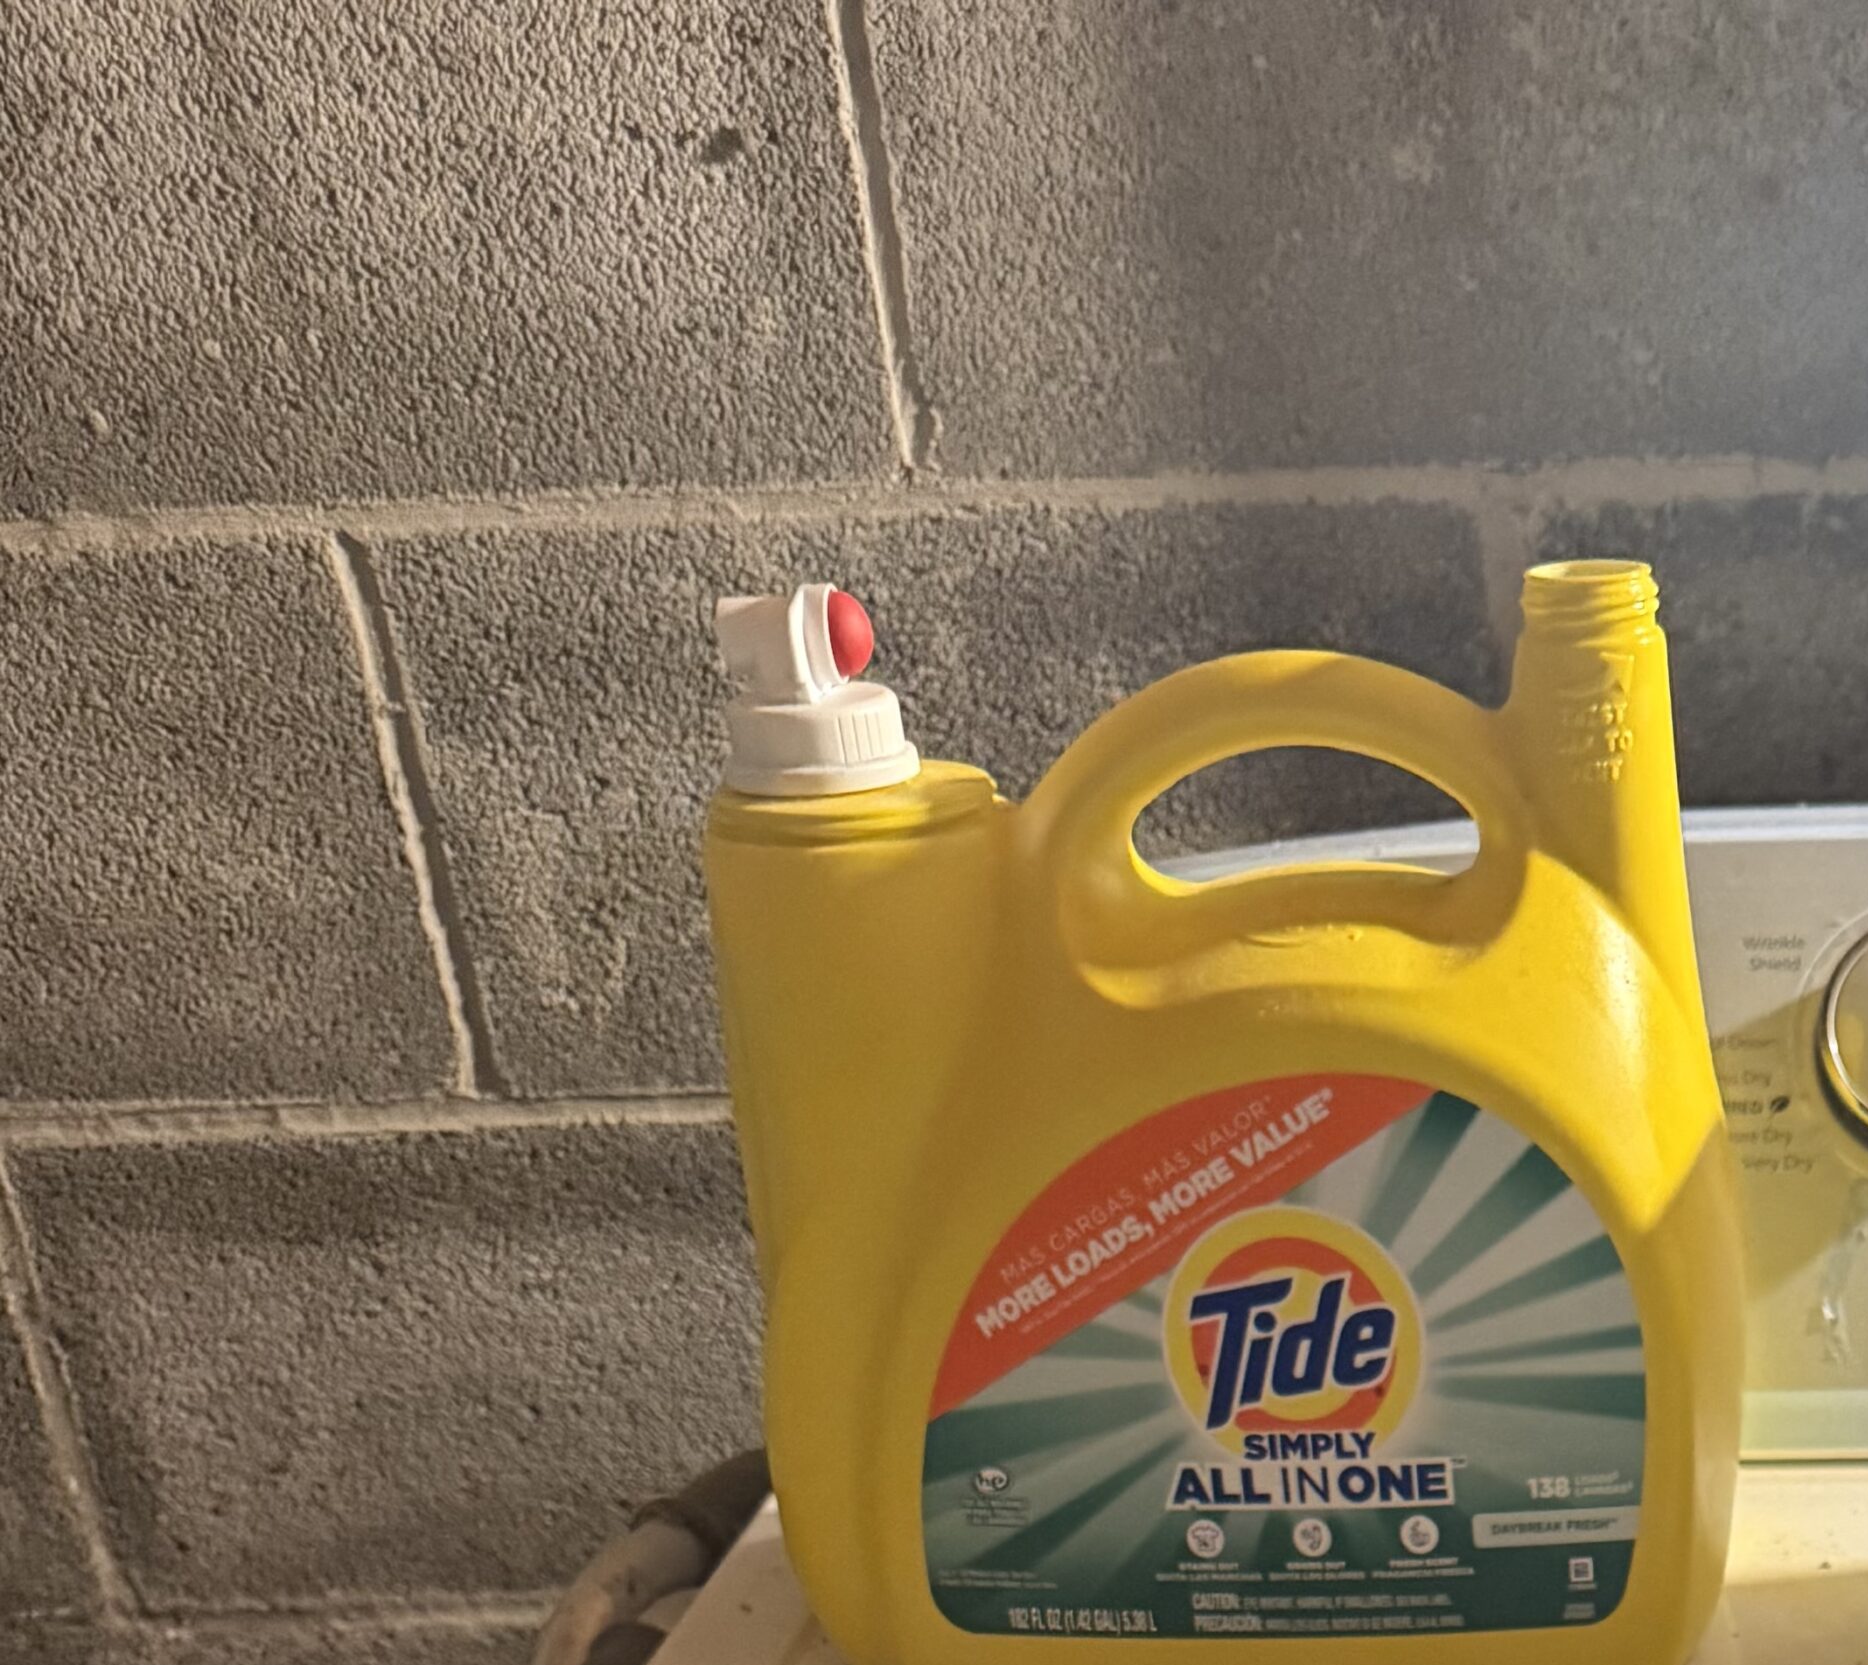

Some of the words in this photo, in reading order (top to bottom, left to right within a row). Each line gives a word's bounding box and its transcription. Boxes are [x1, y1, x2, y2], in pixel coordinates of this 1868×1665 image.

[974, 1274, 1056, 1339] MORE
[1051, 1214, 1155, 1290] LOADS,
[1148, 1156, 1235, 1226] MORE
[1189, 1276, 1396, 1431] Tide
[1243, 1431, 1376, 1461] SIMPLY
[1172, 1467, 1272, 1505] ALL
[1280, 1465, 1330, 1505] IN
[1527, 1475, 1571, 1500] 138
